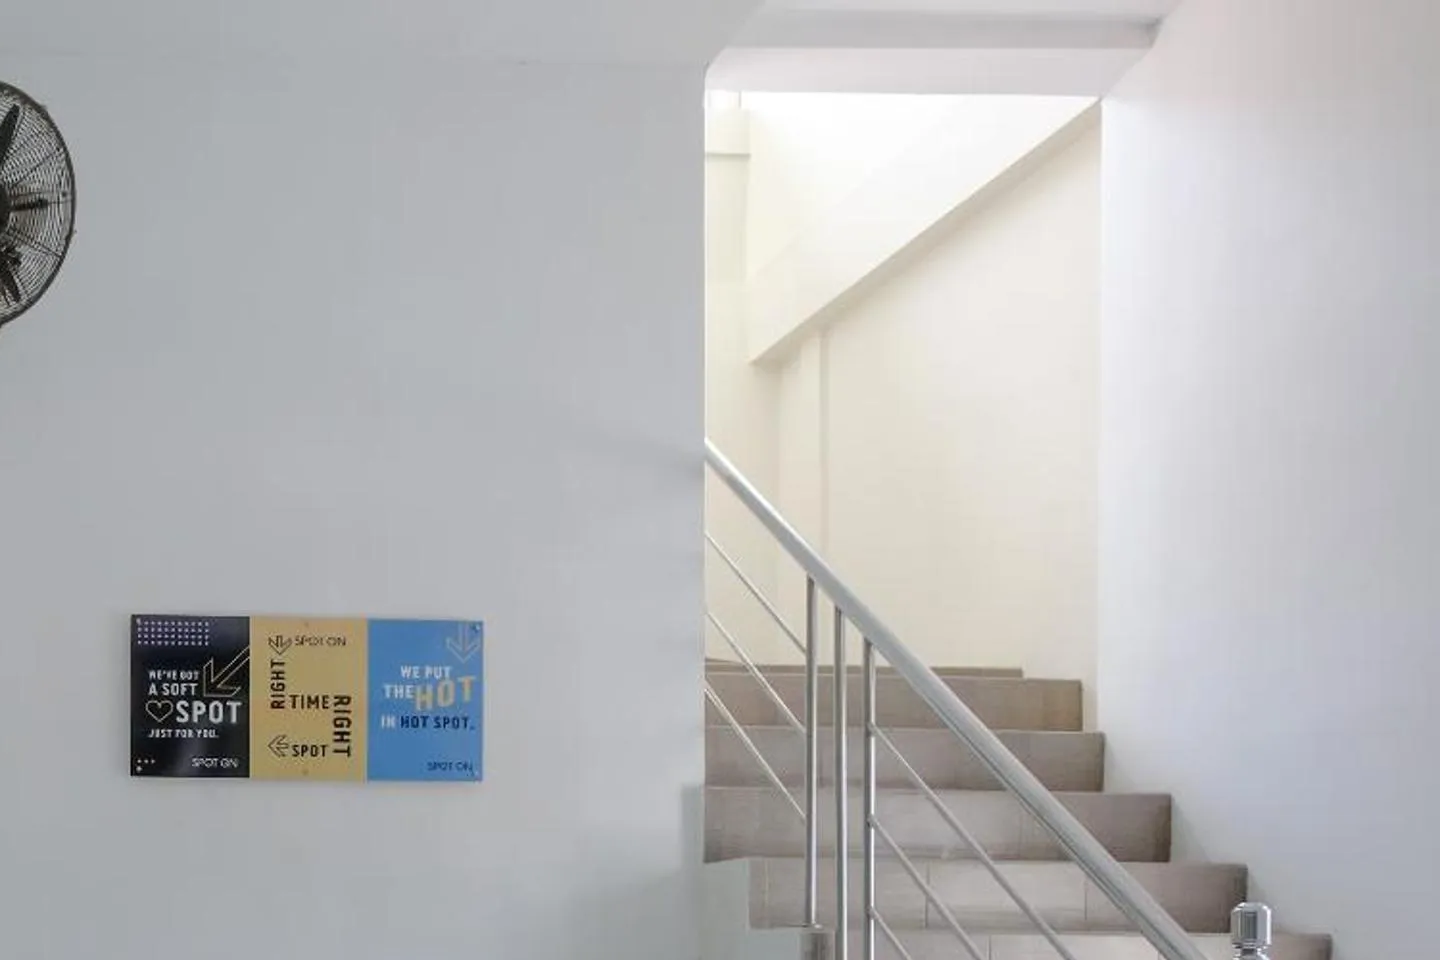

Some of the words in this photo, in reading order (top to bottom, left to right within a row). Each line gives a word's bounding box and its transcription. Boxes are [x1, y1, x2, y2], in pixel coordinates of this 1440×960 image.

[326, 637, 346, 646] ON
[180, 670, 199, 680] GOT
[400, 665, 420, 679] WE
[425, 665, 452, 679] PUT
[149, 682, 158, 696] A
[162, 683, 198, 696] SOFT
[270, 659, 285, 709] RIGHT
[383, 684, 414, 699] THE
[415, 675, 476, 711] HOT
[288, 694, 330, 709] TIME
[176, 700, 242, 723] SPOT
[333, 695, 352, 757] RIGHT
[381, 714, 396, 729] IN
[400, 715, 430, 729] HOT
[148, 729, 173, 738] JUST
[174, 729, 194, 738] FOR
[291, 744, 328, 757] SPOT
